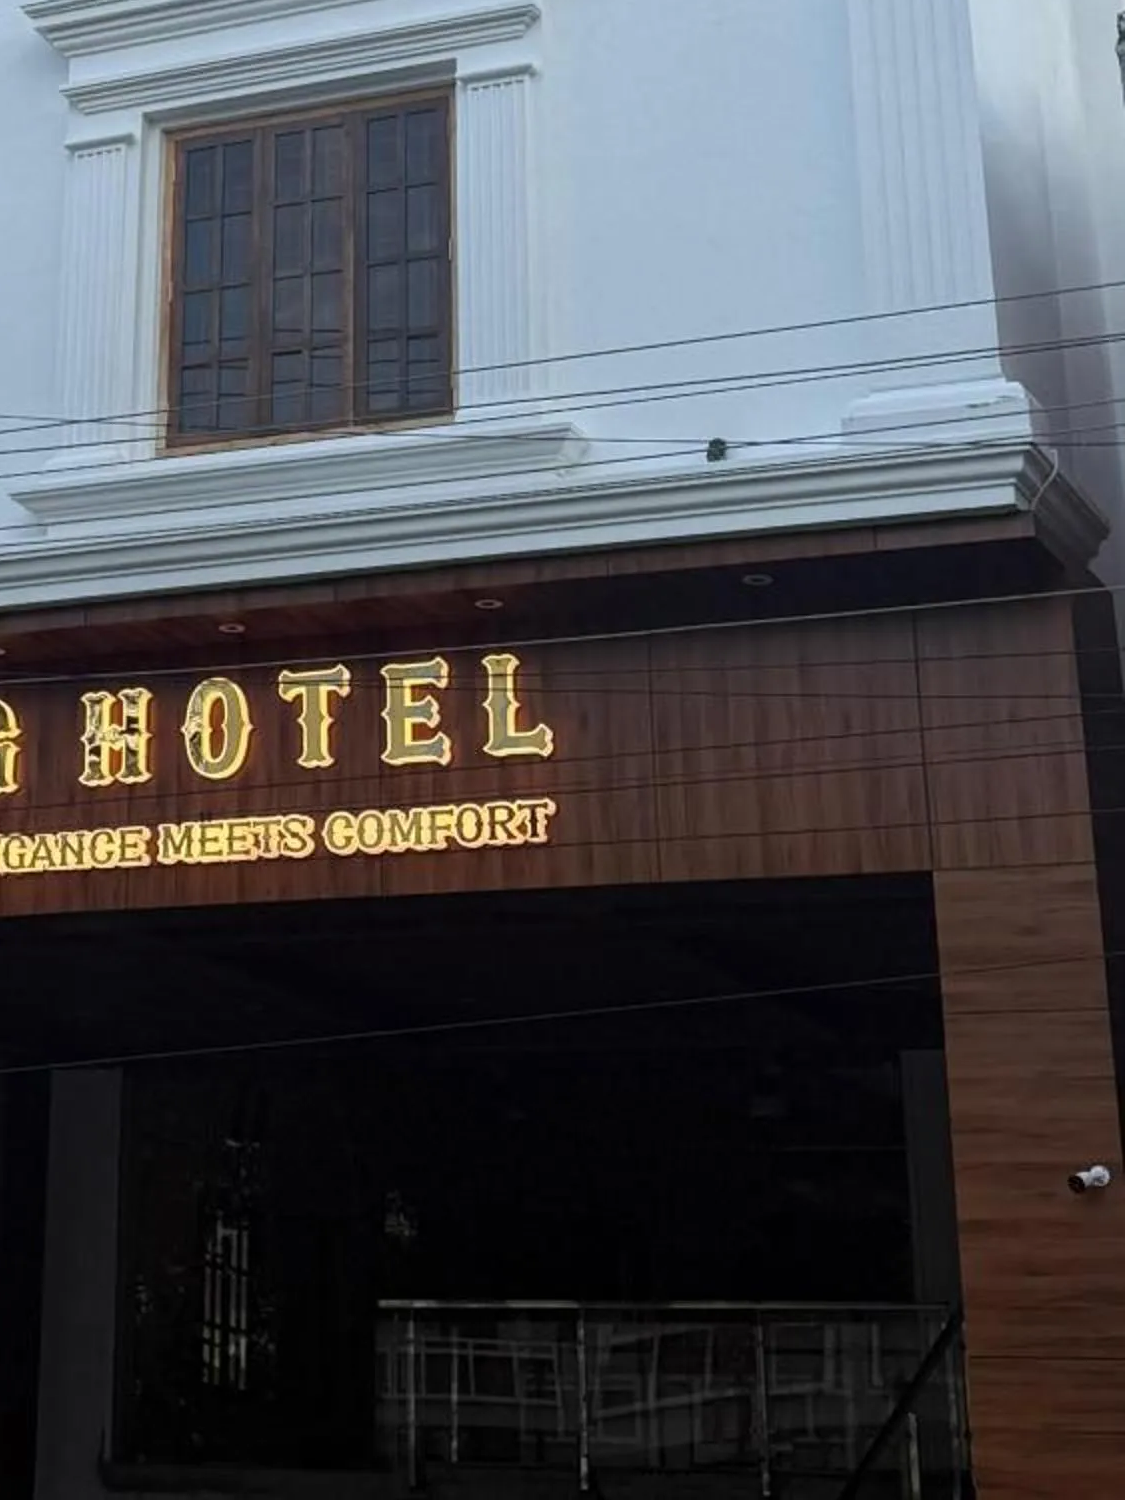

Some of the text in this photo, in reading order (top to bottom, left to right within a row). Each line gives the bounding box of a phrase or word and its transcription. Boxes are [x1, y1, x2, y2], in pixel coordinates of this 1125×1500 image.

[78, 653, 554, 787] HOTEL
[156, 814, 316, 864] MEETS
[321, 798, 556, 855] COMFORT
